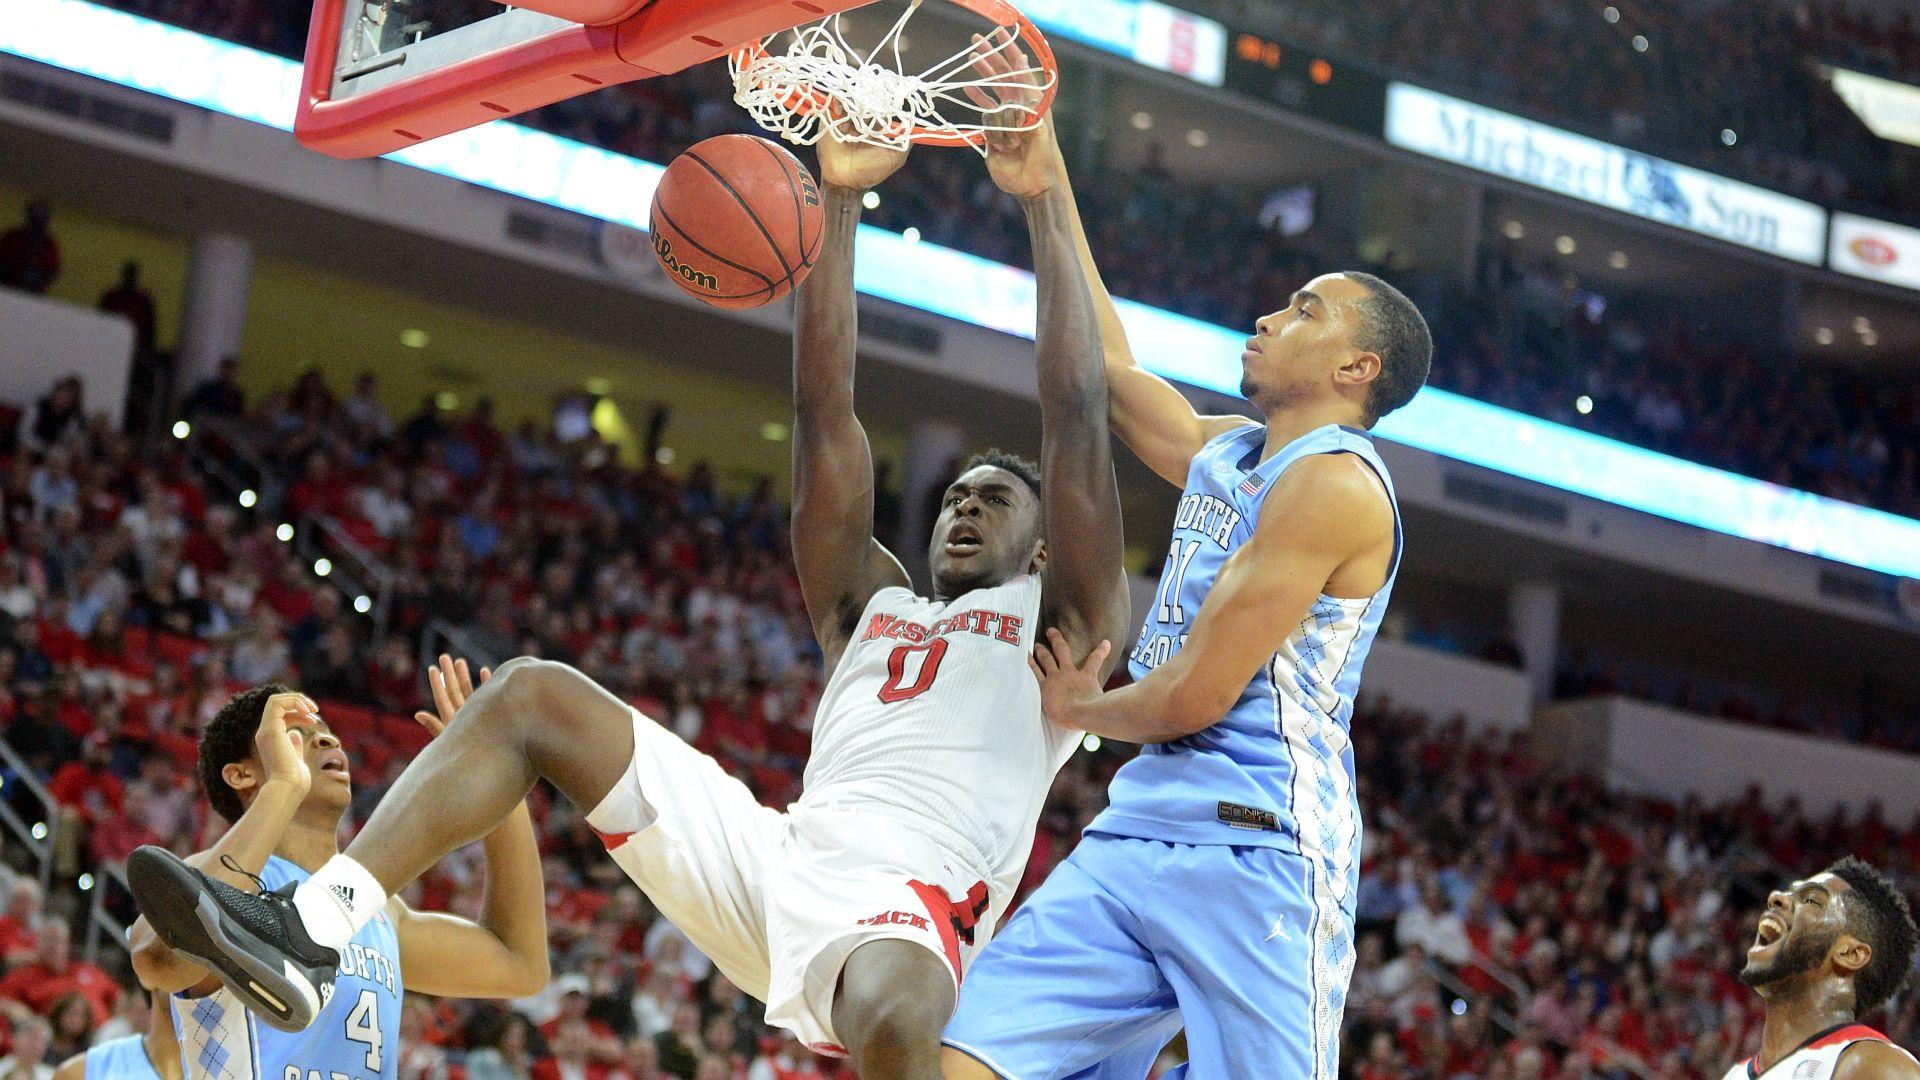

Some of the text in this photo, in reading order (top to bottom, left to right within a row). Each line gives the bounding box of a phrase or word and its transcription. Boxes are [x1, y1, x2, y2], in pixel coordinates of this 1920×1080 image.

[1703, 182, 1778, 250] Son
[1157, 537, 1202, 624] 11
[877, 637, 949, 705] 0
[856, 910, 930, 932] ACK
[336, 943, 396, 999] ORTH
[345, 988, 383, 1073] 4
